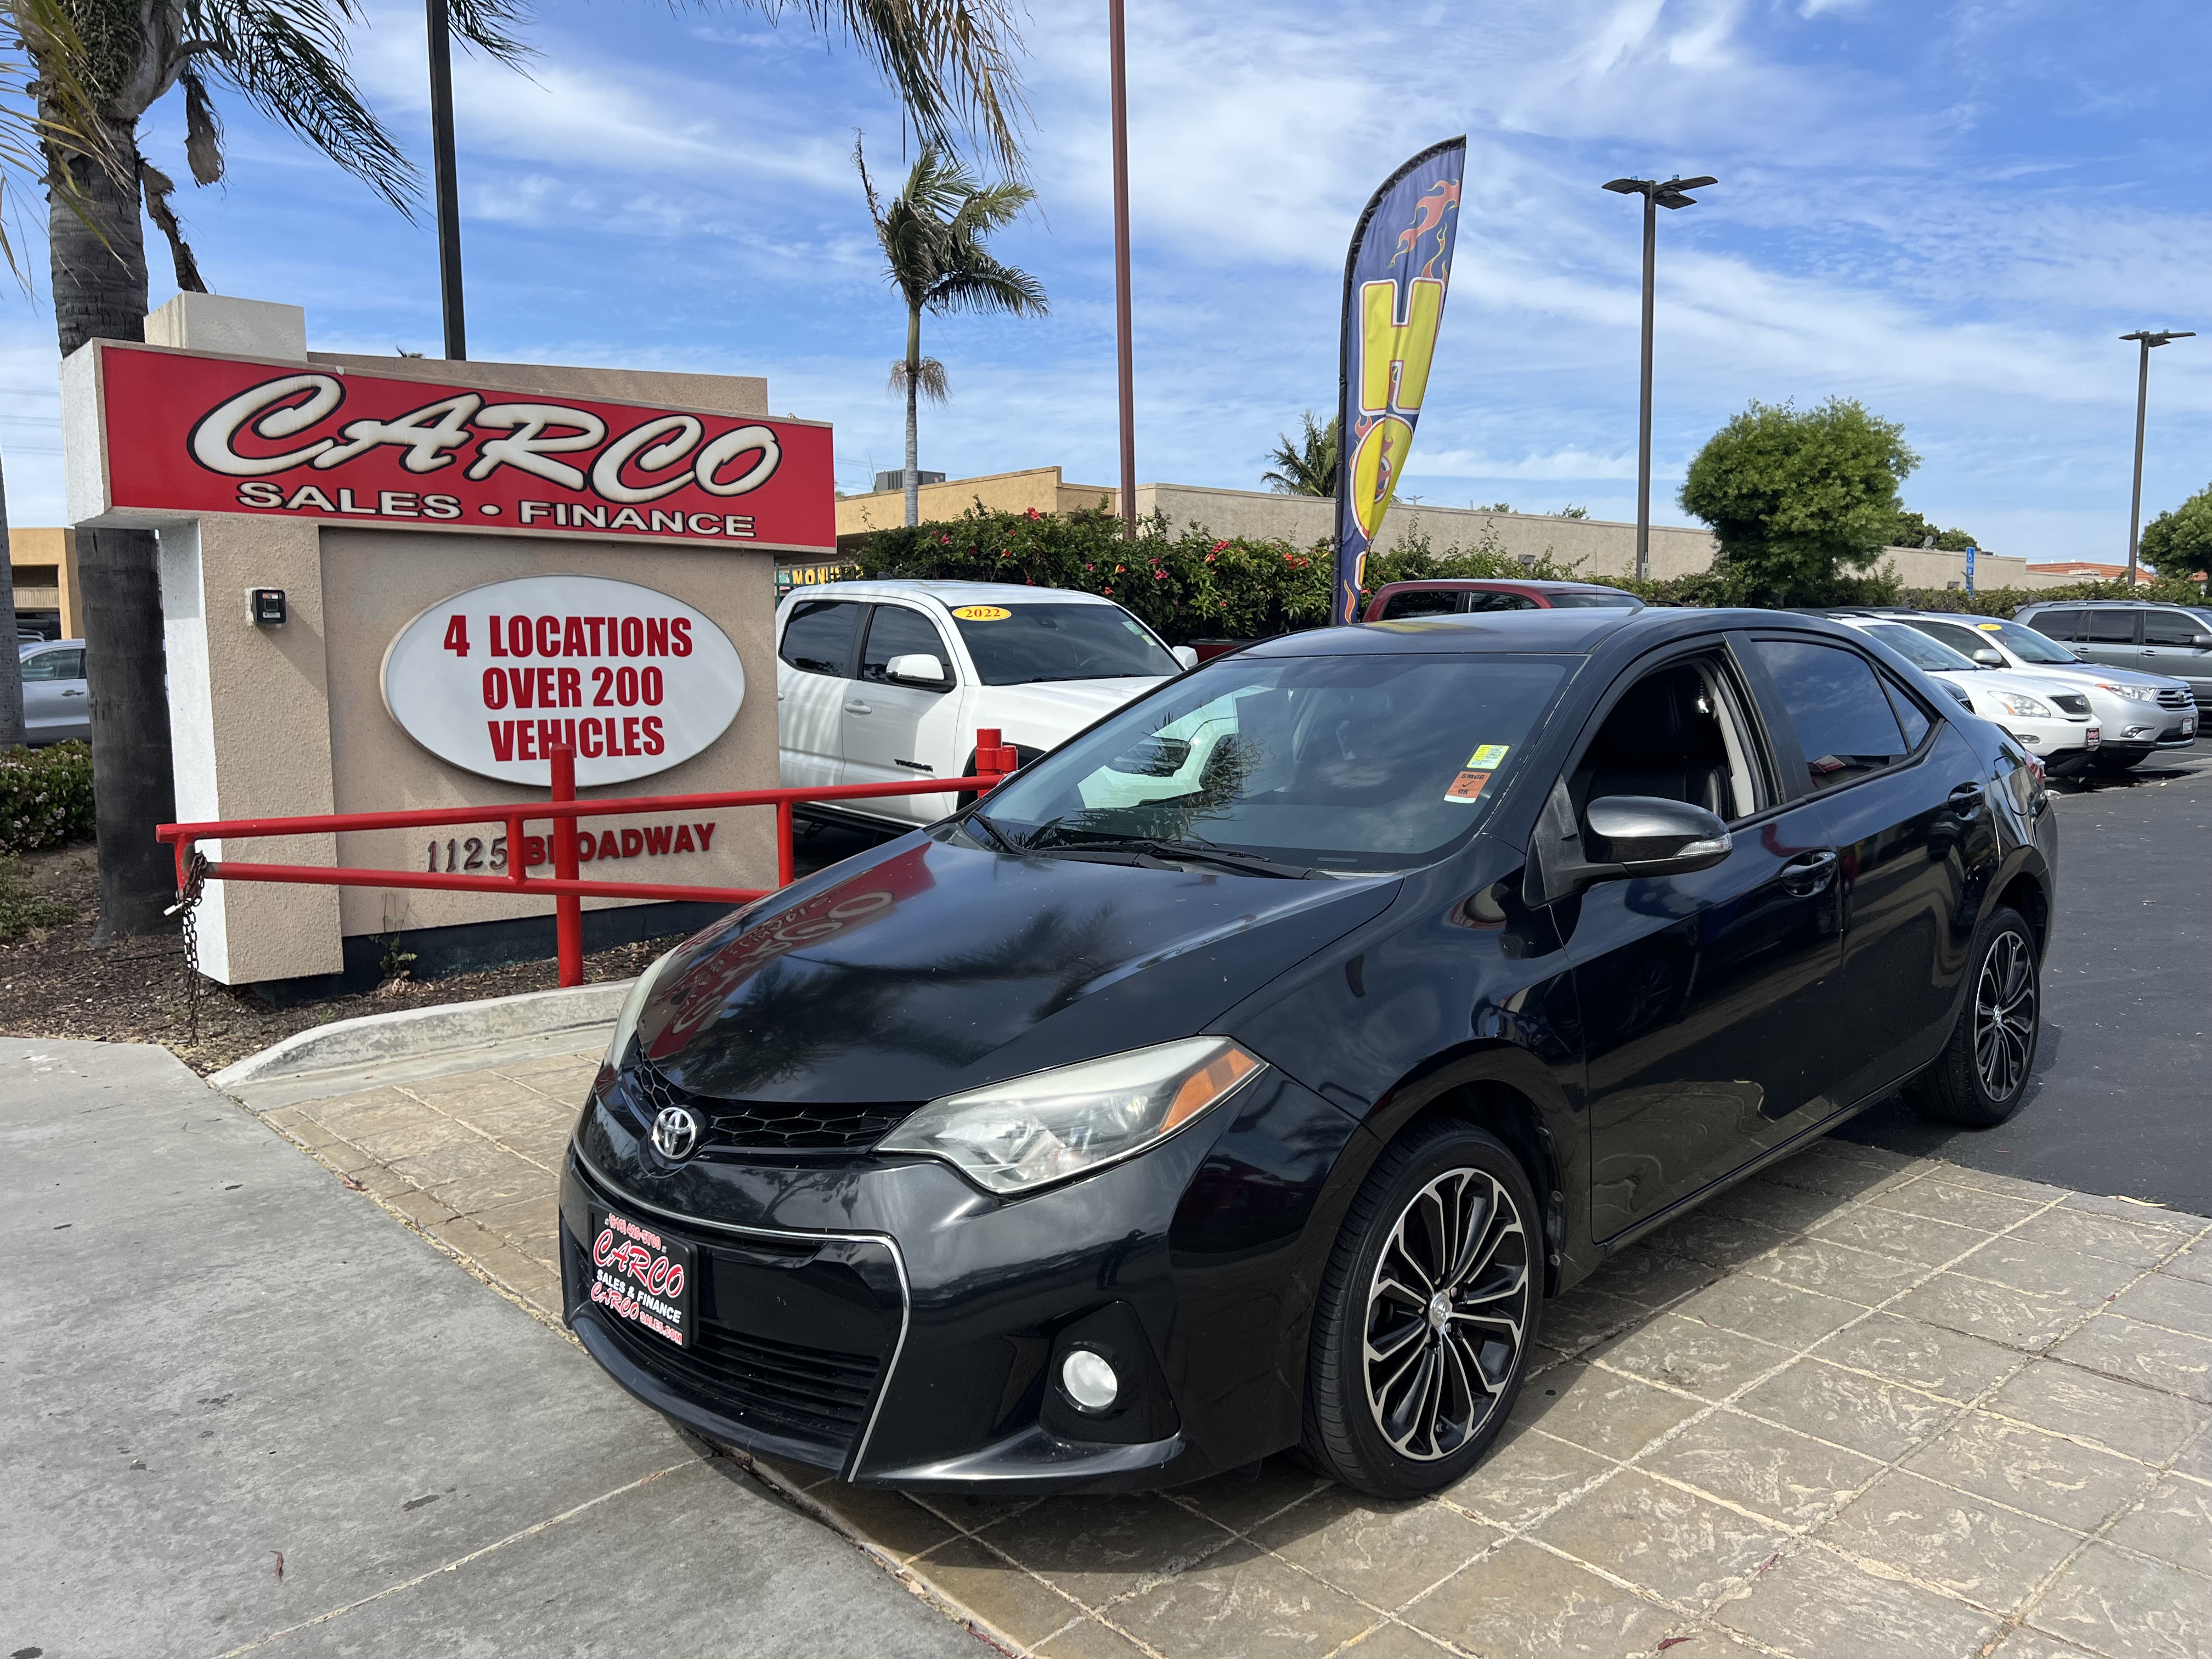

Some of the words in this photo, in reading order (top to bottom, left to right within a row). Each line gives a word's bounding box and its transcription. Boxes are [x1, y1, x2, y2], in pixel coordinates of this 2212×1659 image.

[187, 373, 782, 504] CARCO
[237, 481, 463, 519] SALES
[518, 500, 757, 538] FINANCE
[444, 615, 470, 657] 4
[489, 615, 692, 657] LOCATIONS
[964, 608, 1001, 618] 2022
[483, 667, 582, 709] OVER
[591, 666, 663, 707] 200
[488, 716, 665, 761] VEHICLES
[427, 836, 507, 873] 1125
[523, 822, 715, 866] BOADWAY
[593, 1228, 684, 1298] CARCO
[596, 1269, 626, 1294] SALES
[627, 1285, 635, 1300] &
[637, 1290, 682, 1324] FINANCE
